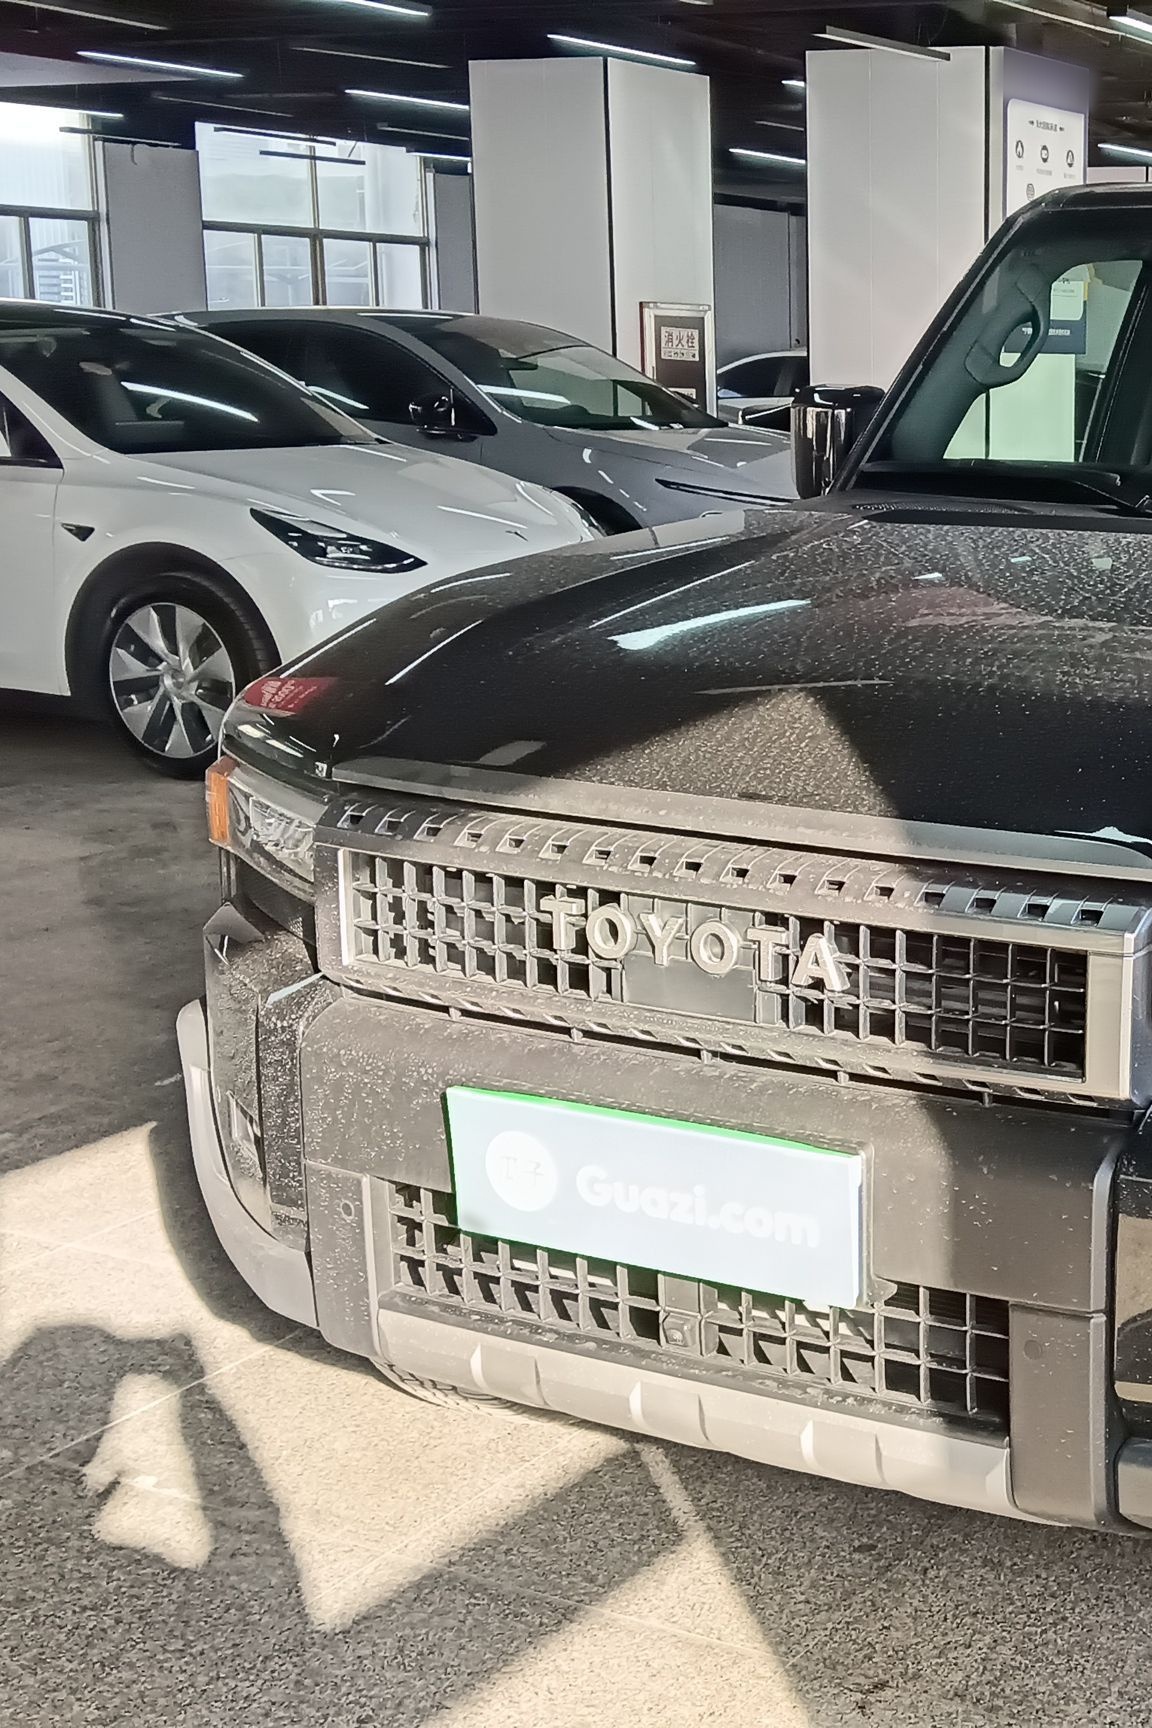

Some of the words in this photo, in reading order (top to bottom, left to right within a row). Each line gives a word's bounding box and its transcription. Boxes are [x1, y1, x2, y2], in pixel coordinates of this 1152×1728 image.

[664, 330, 695, 348] 消火栓
[541, 894, 850, 992] TOYOTA
